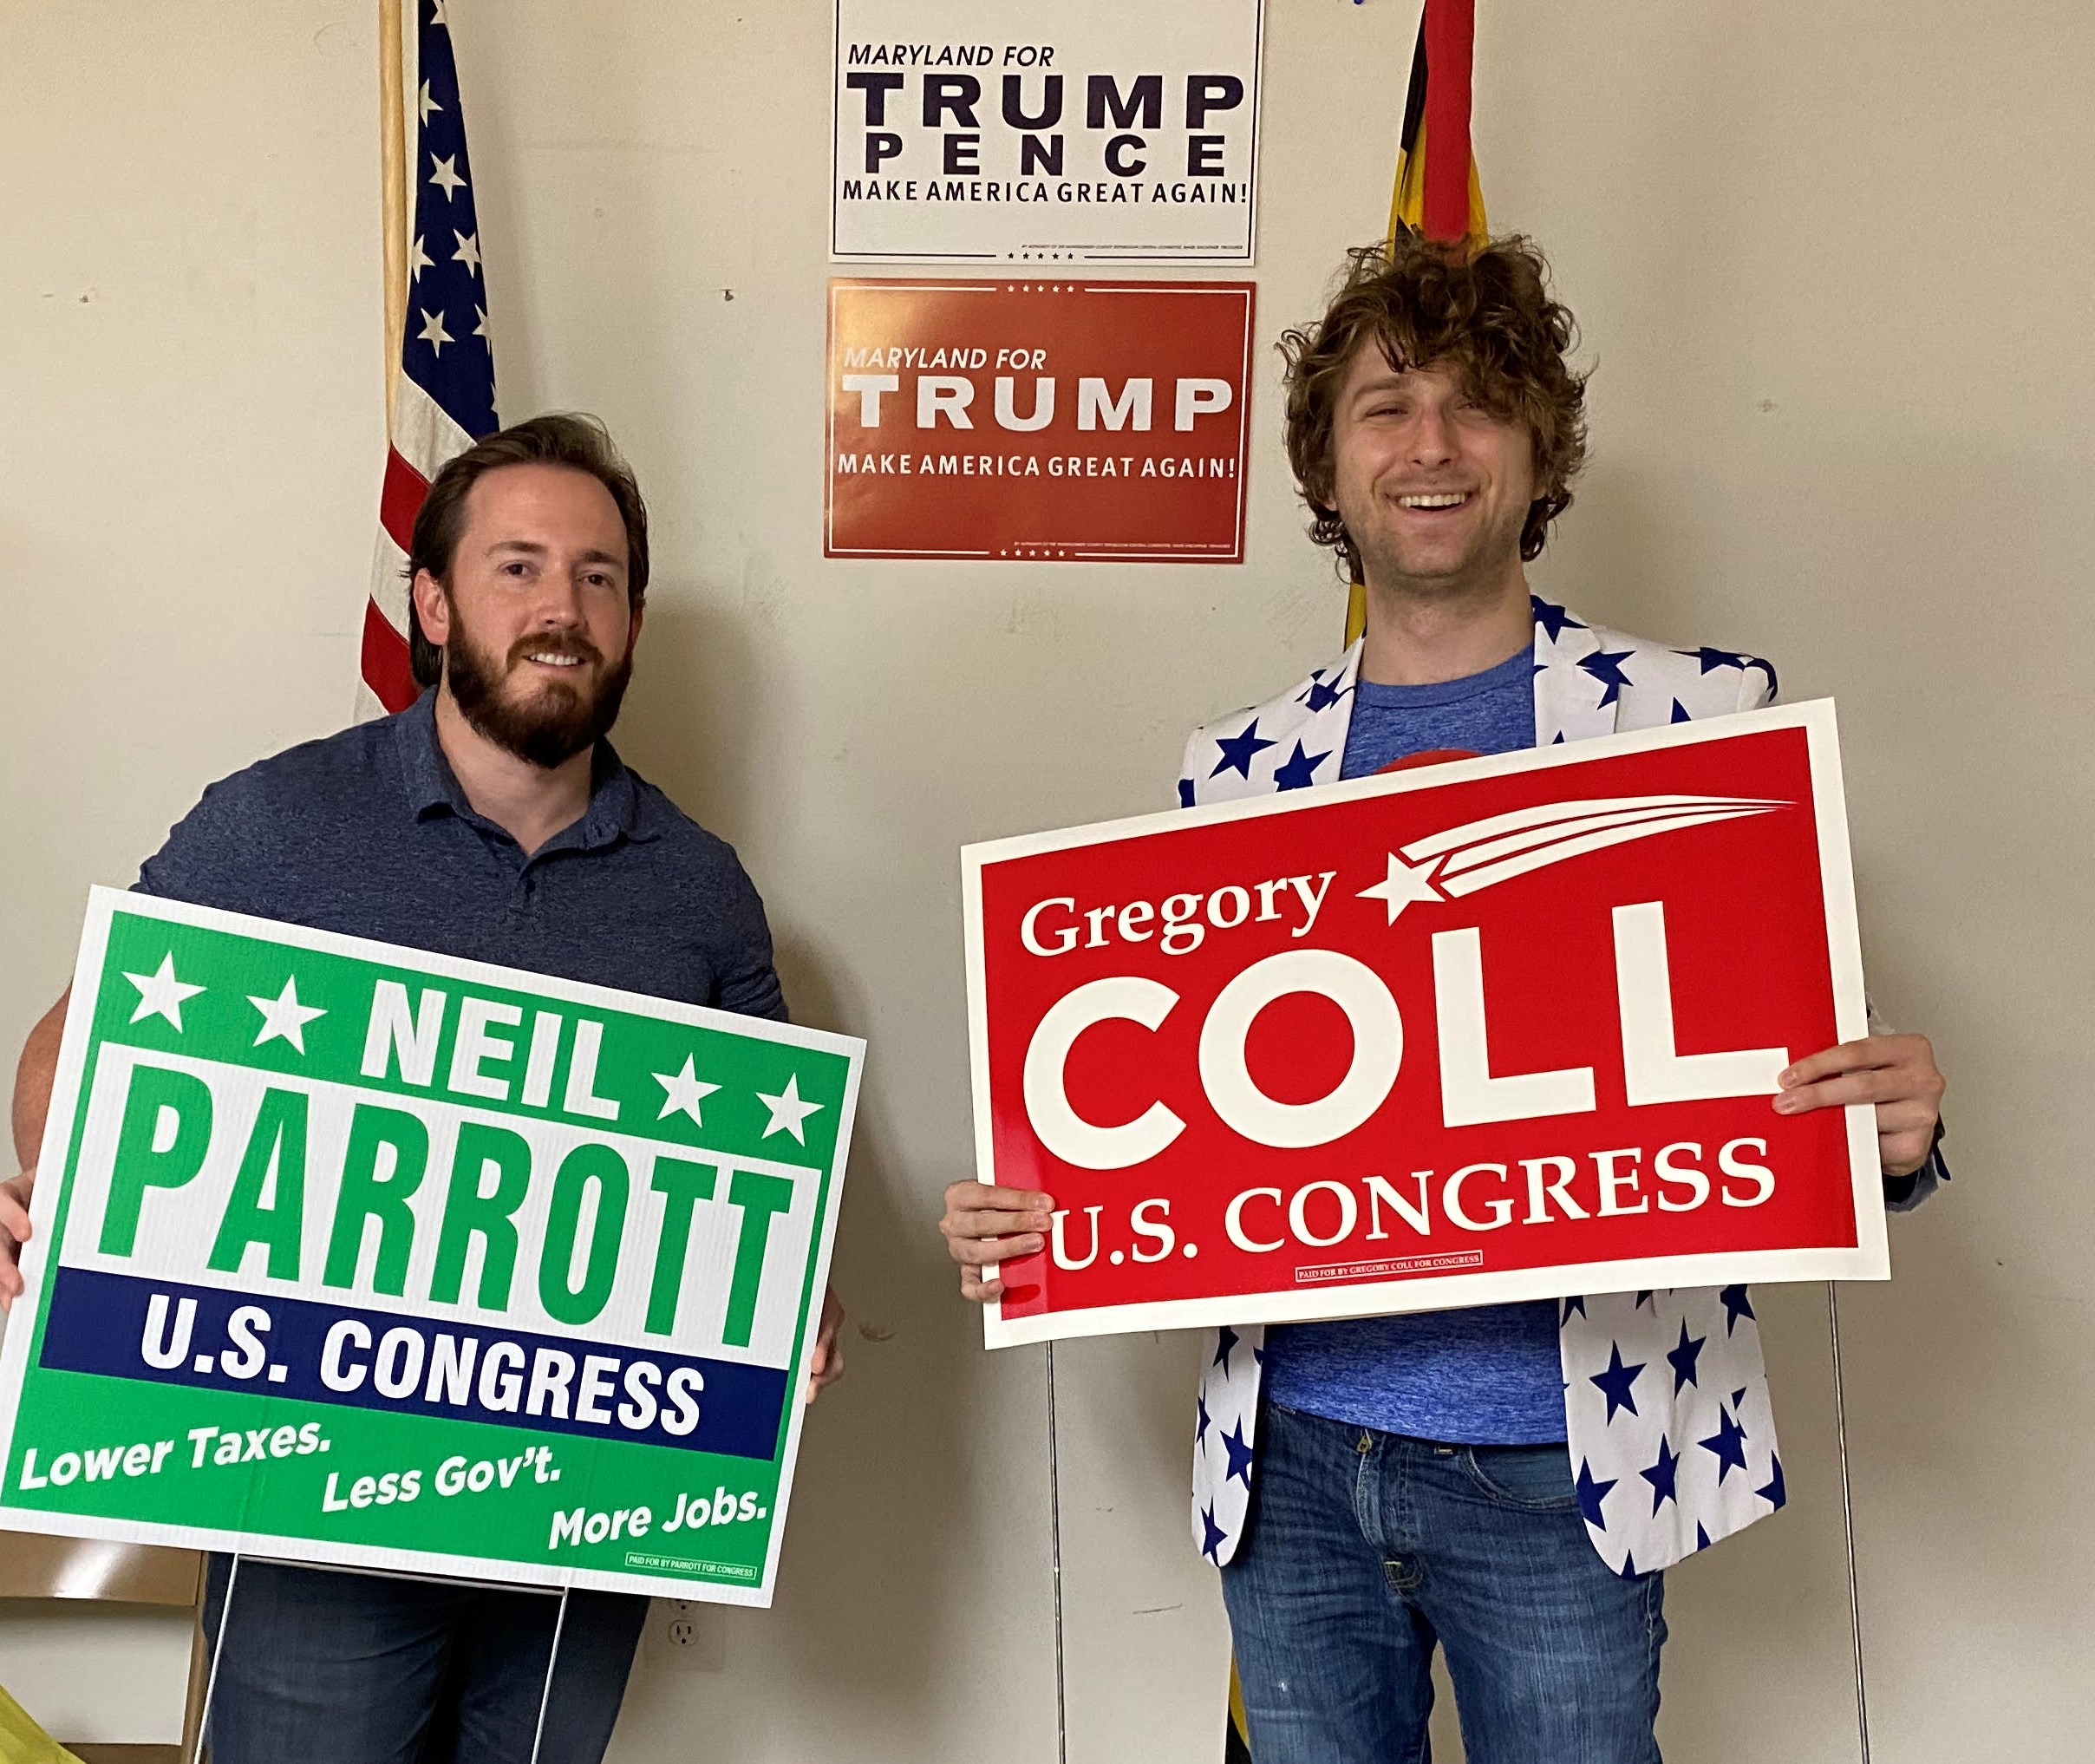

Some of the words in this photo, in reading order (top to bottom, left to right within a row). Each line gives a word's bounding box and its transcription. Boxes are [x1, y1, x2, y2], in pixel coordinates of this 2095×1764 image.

[848, 44, 994, 67] MARYLAND
[1002, 46, 1054, 67] FOR
[846, 72, 1244, 130] TRUMP
[865, 132, 1225, 177] PENCE
[843, 180, 917, 201] MAKE
[926, 181, 1049, 202] AMERICA
[1057, 182, 1143, 203] GREAT
[1151, 183, 1248, 204] AGAIN!
[844, 348, 987, 369] MARYLAND
[995, 349, 1047, 370] FOR
[842, 374, 1233, 432] TRUMP
[838, 454, 911, 474] MAKE
[919, 455, 1040, 476] AMERICA
[1048, 456, 1133, 478] GREAT
[1140, 458, 1236, 479] AGAIN!
[1020, 869, 1337, 958] Gregory
[360, 979, 621, 1121] NEIL
[1023, 900, 1790, 1171] COLL
[96, 1062, 795, 1348] PARROTT
[1049, 1198, 1198, 1271] U.S.
[1224, 1137, 1776, 1253] CONGRESS
[1299, 1270, 1318, 1278] PAID
[1320, 1269, 1336, 1277] FOR
[1349, 1264, 1389, 1274] GREGORY
[1390, 1262, 1414, 1271] COLL
[1414, 1259, 1432, 1268] FOR
[1433, 1254, 1480, 1266] CONGRESS
[140, 1293, 288, 1384] U.S.
[318, 1318, 705, 1437] CONGRESS
[18, 1437, 173, 1491] Lower
[186, 1422, 330, 1470] Taxes.
[322, 1463, 421, 1513] Less
[435, 1445, 561, 1497] Gov't.
[548, 1506, 649, 1550] More
[662, 1485, 767, 1532] Jobs.
[629, 1555, 645, 1565] PAID
[645, 1557, 660, 1566] FOR
[660, 1559, 671, 1568] BY
[670, 1560, 702, 1571] PARROTT
[702, 1564, 716, 1573] FOR
[716, 1565, 754, 1577] CONGRESS
